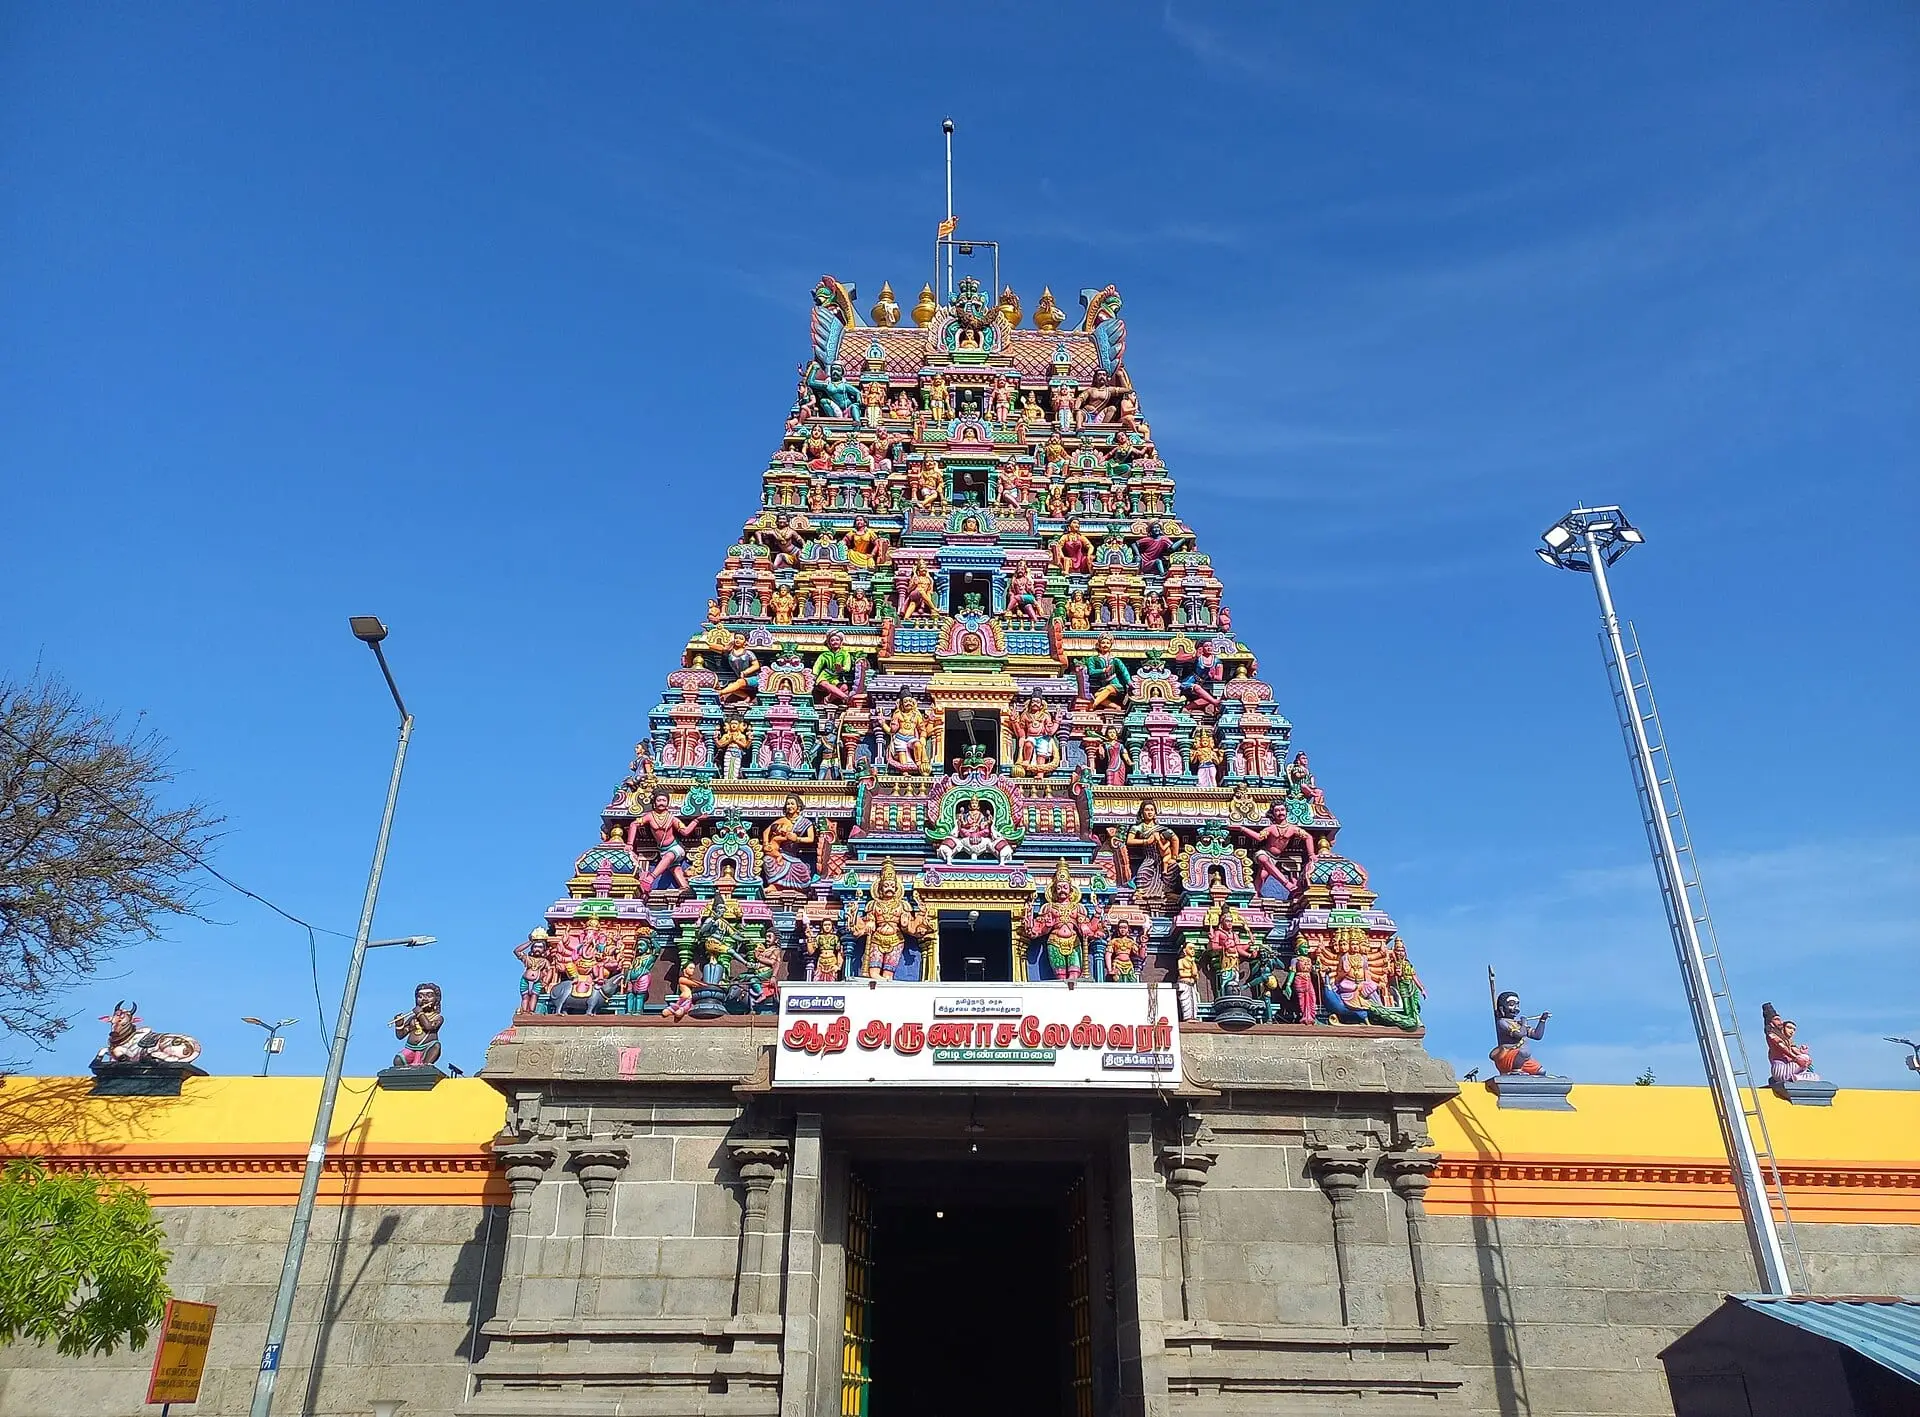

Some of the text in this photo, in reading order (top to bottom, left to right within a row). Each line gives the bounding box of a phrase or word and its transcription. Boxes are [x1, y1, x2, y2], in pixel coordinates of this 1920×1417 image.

[788, 996, 845, 1009] அருள்மிகு
[783, 1015, 1174, 1056] ஆதி அருணாசலேஸ்வரர்
[937, 1049, 1054, 1060] அடி அண்ணாமலை
